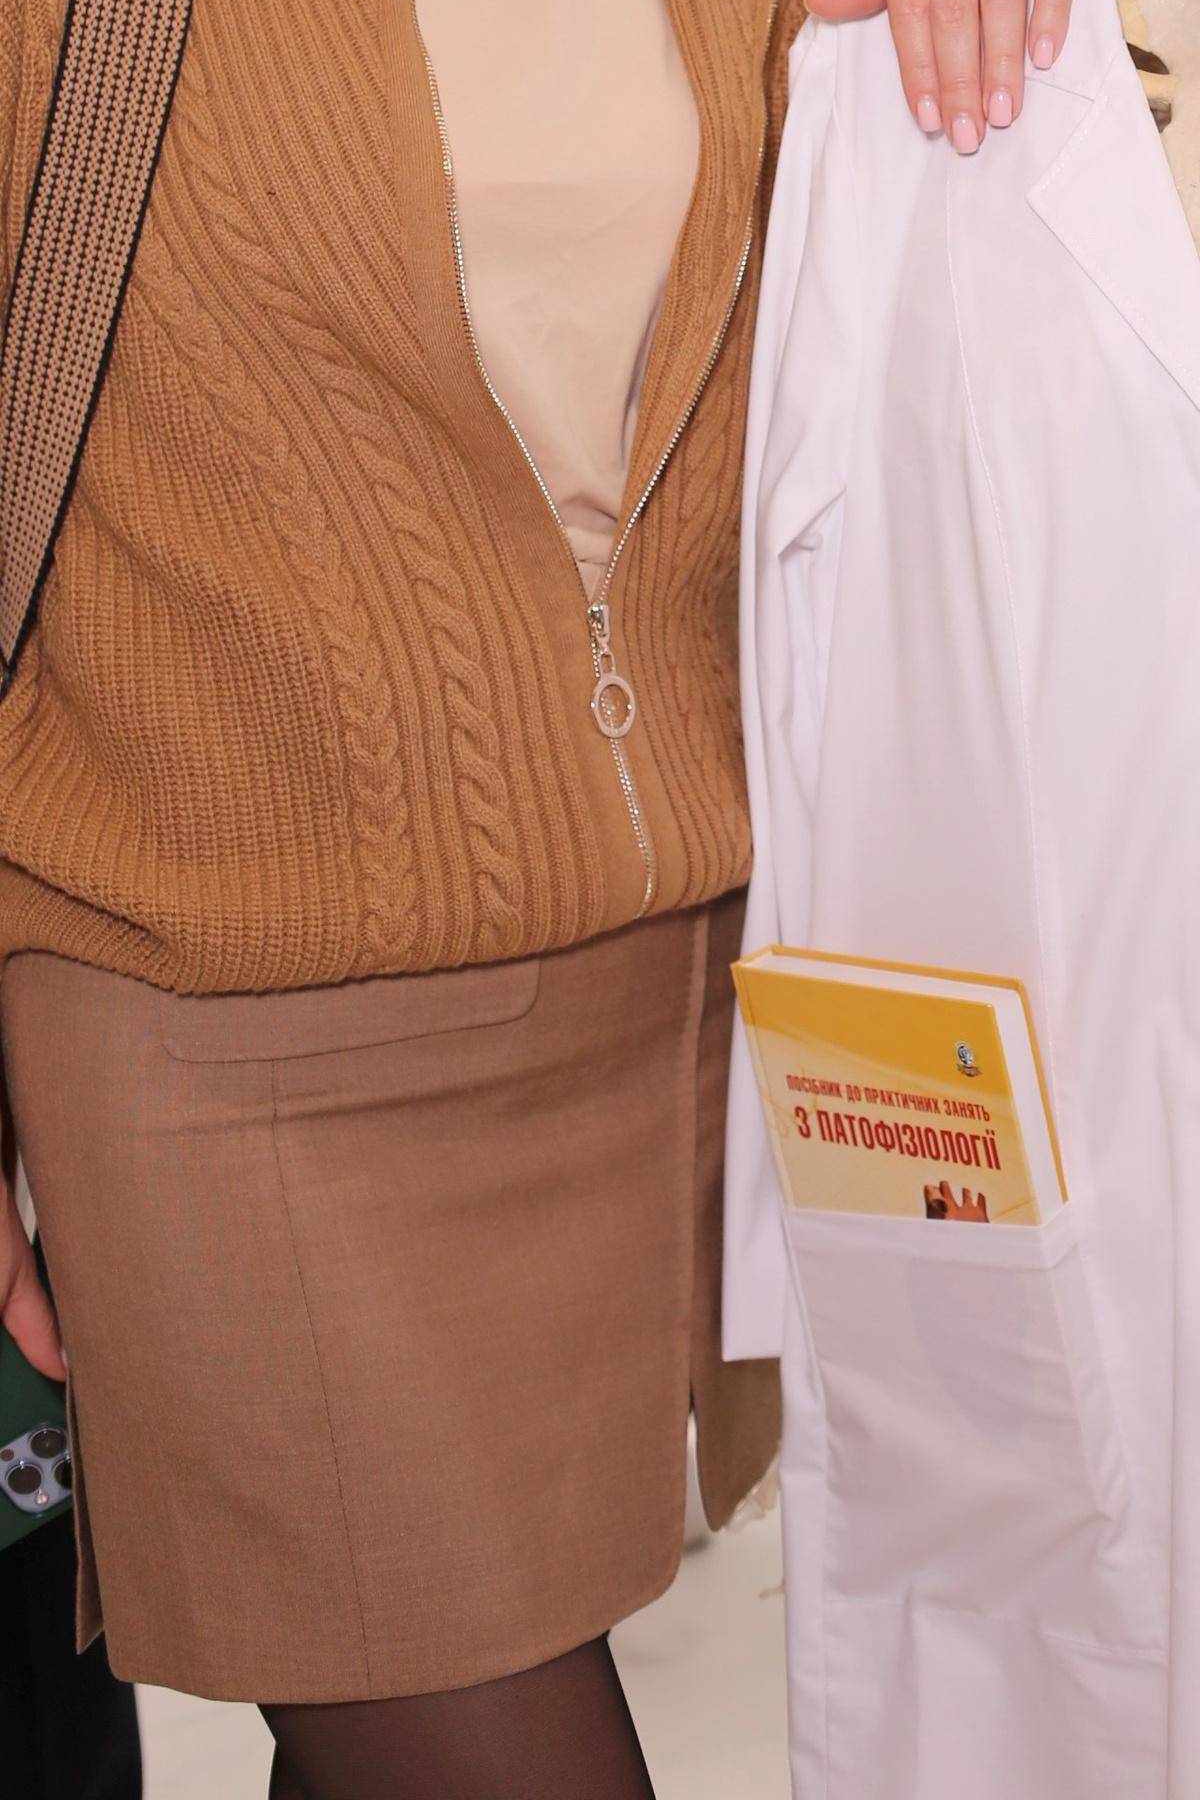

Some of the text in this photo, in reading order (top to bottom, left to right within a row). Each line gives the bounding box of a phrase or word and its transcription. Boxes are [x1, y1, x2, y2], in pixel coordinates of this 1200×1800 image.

[786, 1074, 990, 1122] ПОСІБНИК ДО ПРАКТИЧНИХ ЗАНЯТЬ
[816, 1109, 1001, 1170] ПАТОФІЗІОЛОГІЇ
